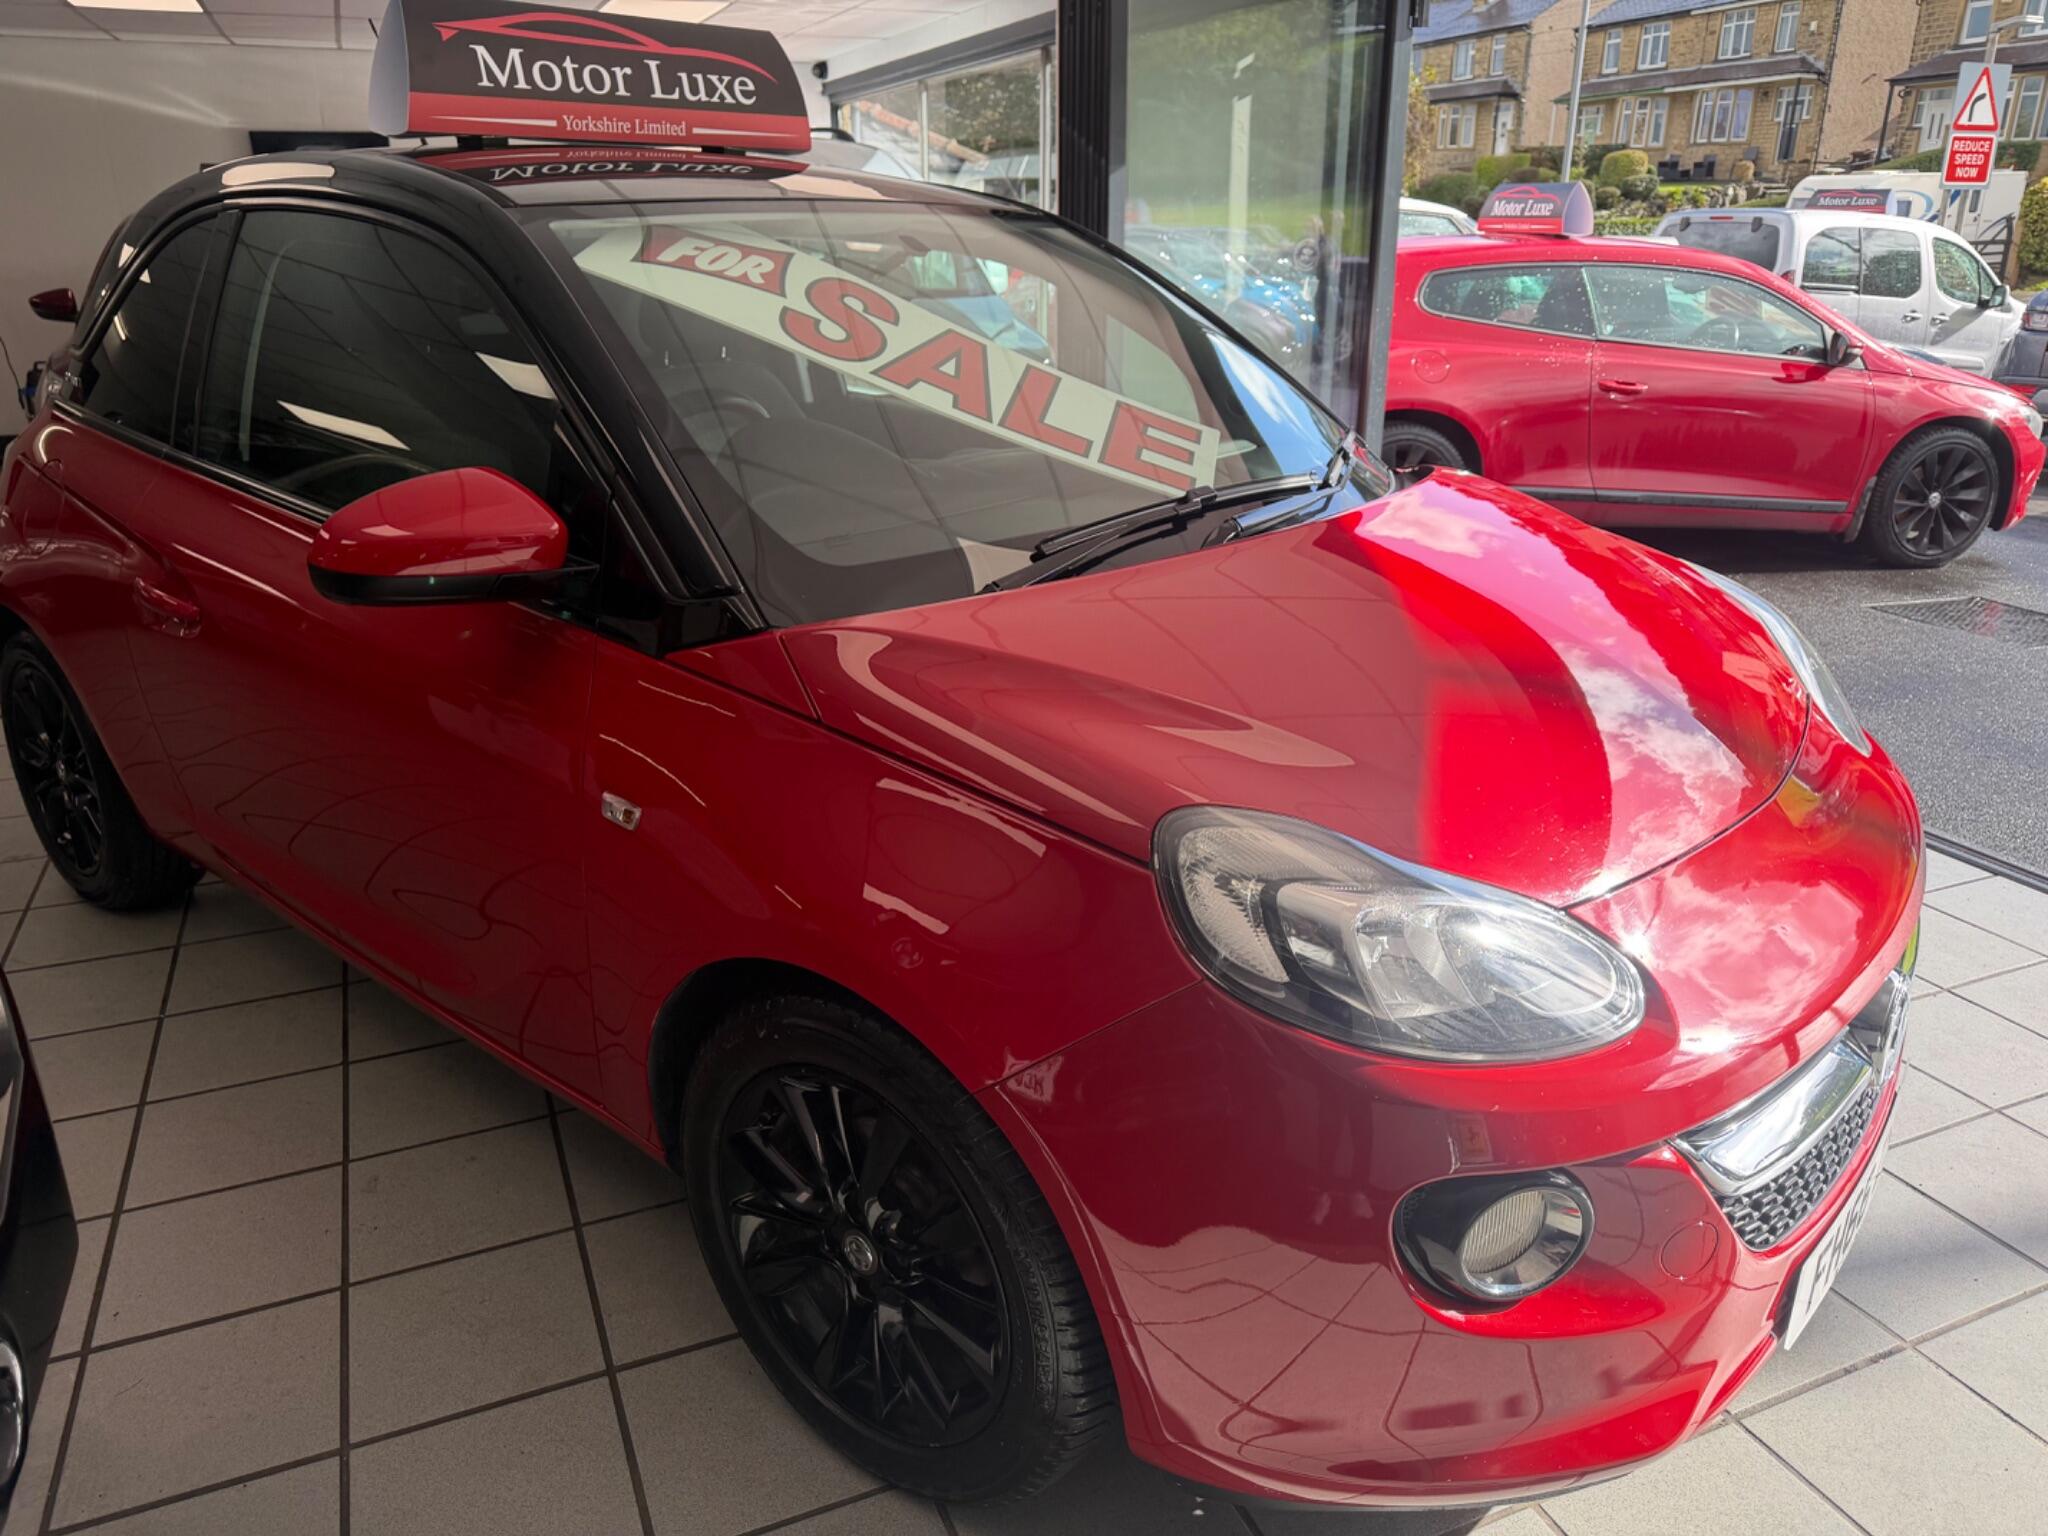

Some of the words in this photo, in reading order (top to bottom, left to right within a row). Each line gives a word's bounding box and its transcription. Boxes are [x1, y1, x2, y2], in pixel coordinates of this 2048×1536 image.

[469, 44, 632, 97] Motor
[643, 59, 757, 105] Luxe
[562, 115, 631, 134] Yorkshire
[635, 119, 687, 137] Limited
[1953, 140, 1991, 152] REDUCE
[1954, 153, 1985, 165] SPEED
[1955, 167, 1979, 178] NOW
[1490, 200, 1524, 216] Motor
[1524, 200, 1554, 216] Luxe
[1817, 196, 1851, 206] Motor
[1851, 196, 1877, 206] Luxe
[656, 237, 776, 286] FOR
[778, 276, 1203, 490] SALE
